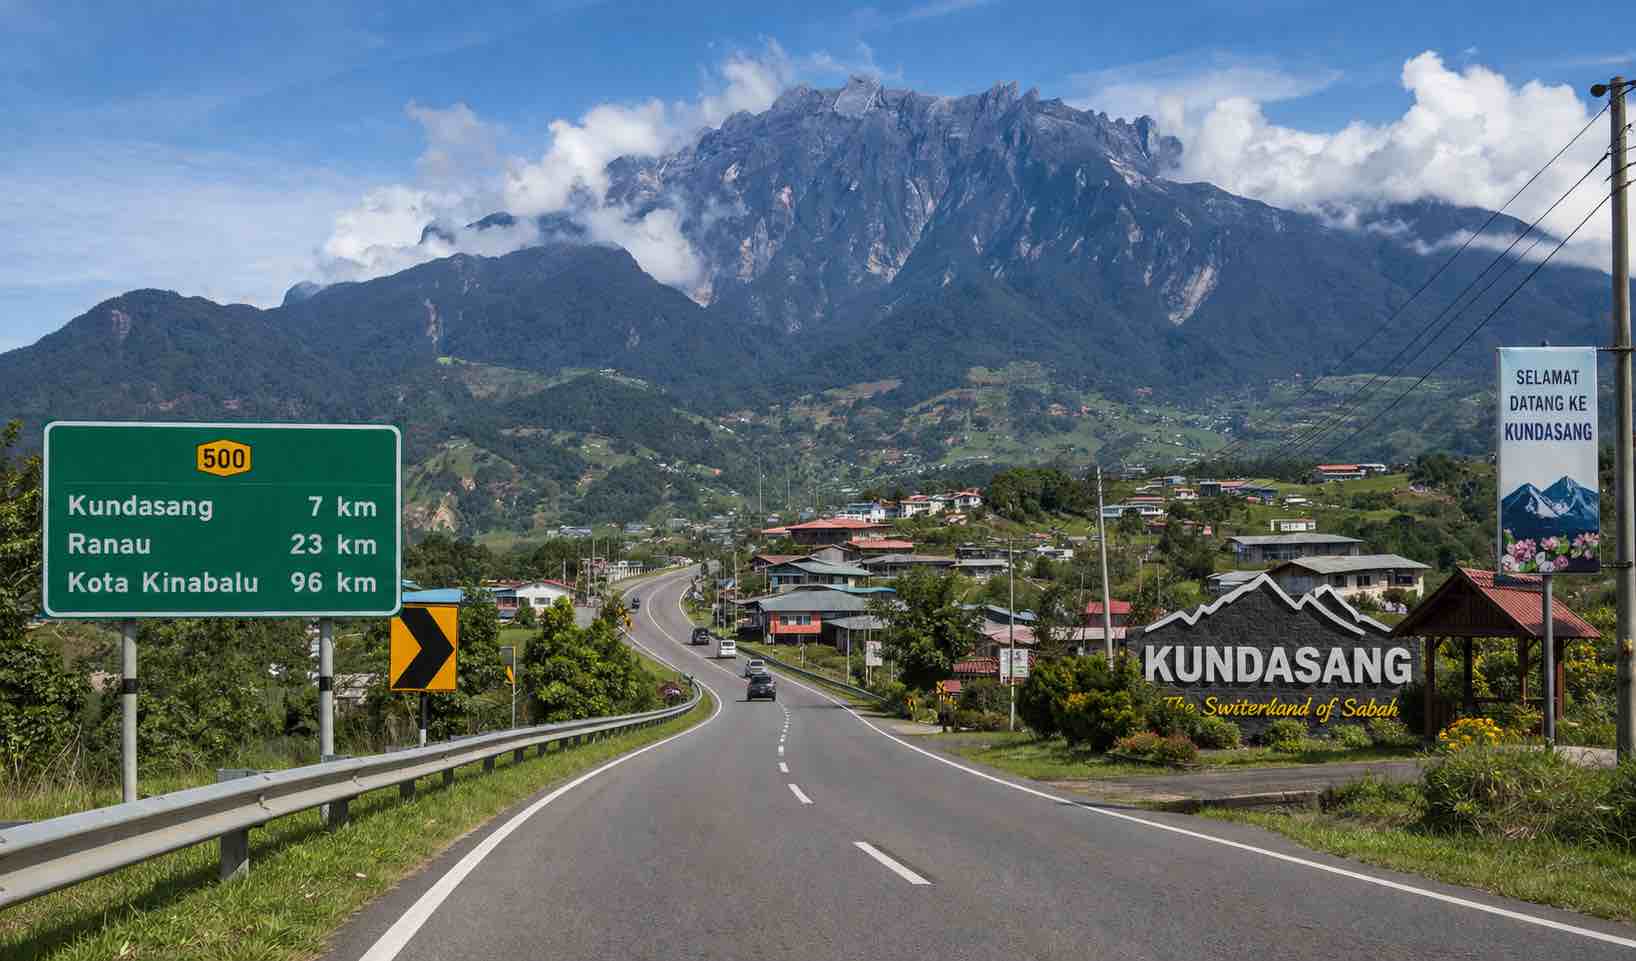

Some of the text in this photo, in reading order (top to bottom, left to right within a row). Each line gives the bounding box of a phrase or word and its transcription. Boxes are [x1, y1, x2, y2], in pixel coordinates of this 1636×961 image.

[1516, 369, 1580, 385] SELAMAT
[1510, 395, 1587, 412] DATANG KE
[1504, 422, 1593, 441] KUNDASANG
[203, 448, 246, 469] 500
[68, 495, 377, 522] Kundasang 7 km
[68, 533, 377, 555] Ranau 23 km
[68, 571, 377, 593] Kota Kinabalu 96 km
[1144, 644, 1413, 685] KUNDASANG
[1316, 697, 1339, 723] of
[1342, 698, 1399, 717] Sabah
